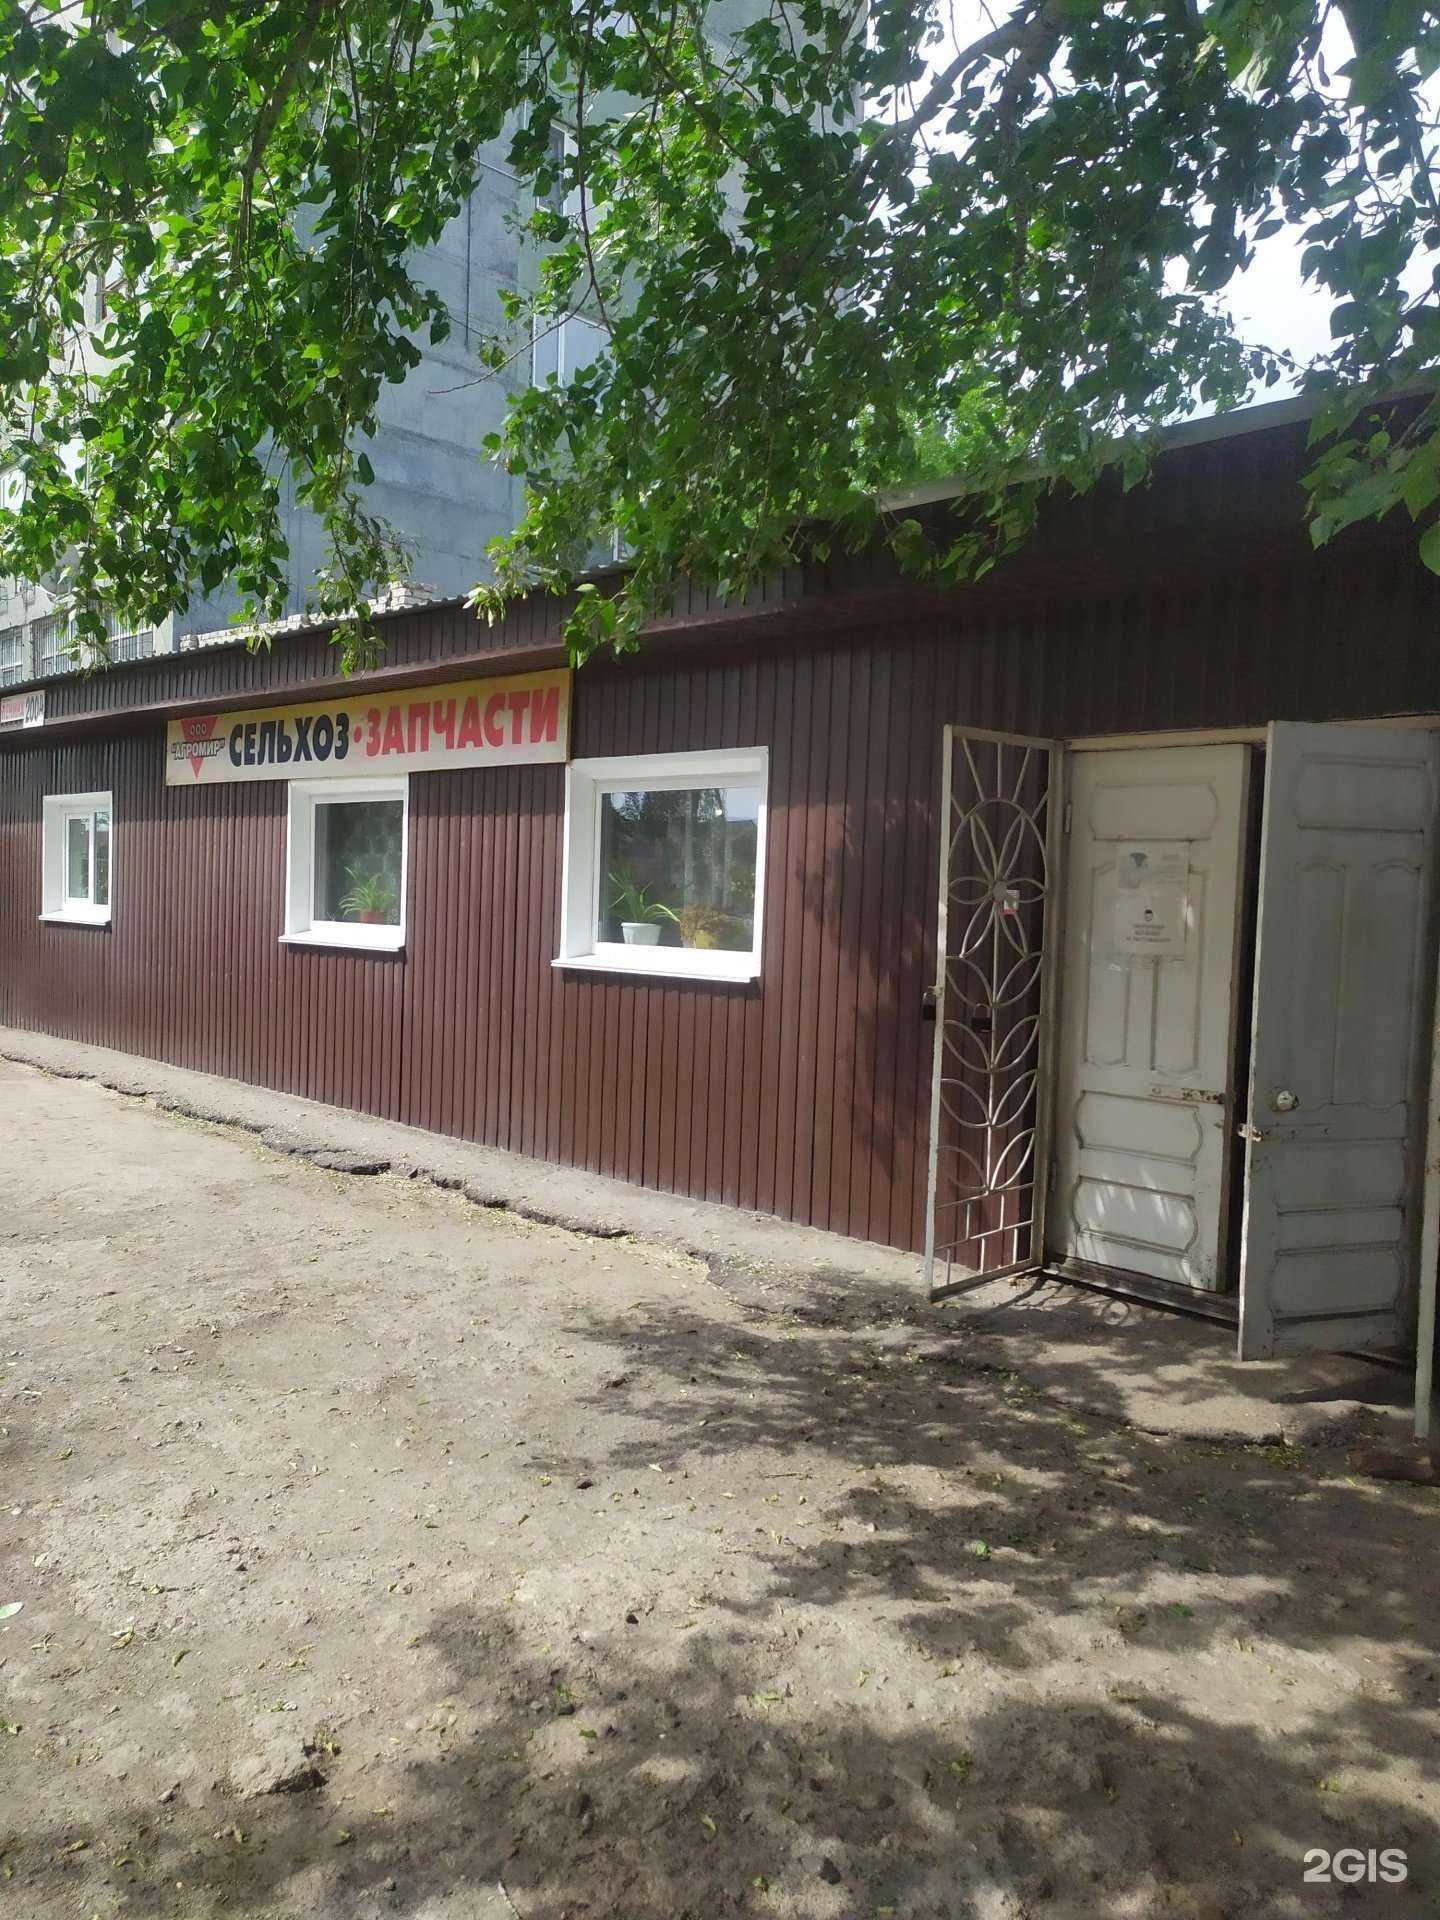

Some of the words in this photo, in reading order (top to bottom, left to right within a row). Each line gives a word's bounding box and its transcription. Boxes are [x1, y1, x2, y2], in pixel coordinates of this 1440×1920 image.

[190, 723, 207, 736] ООО
[229, 712, 350, 767] СЕЛЬХОЗ
[366, 687, 560, 757] ЗАПЧАСТИ
